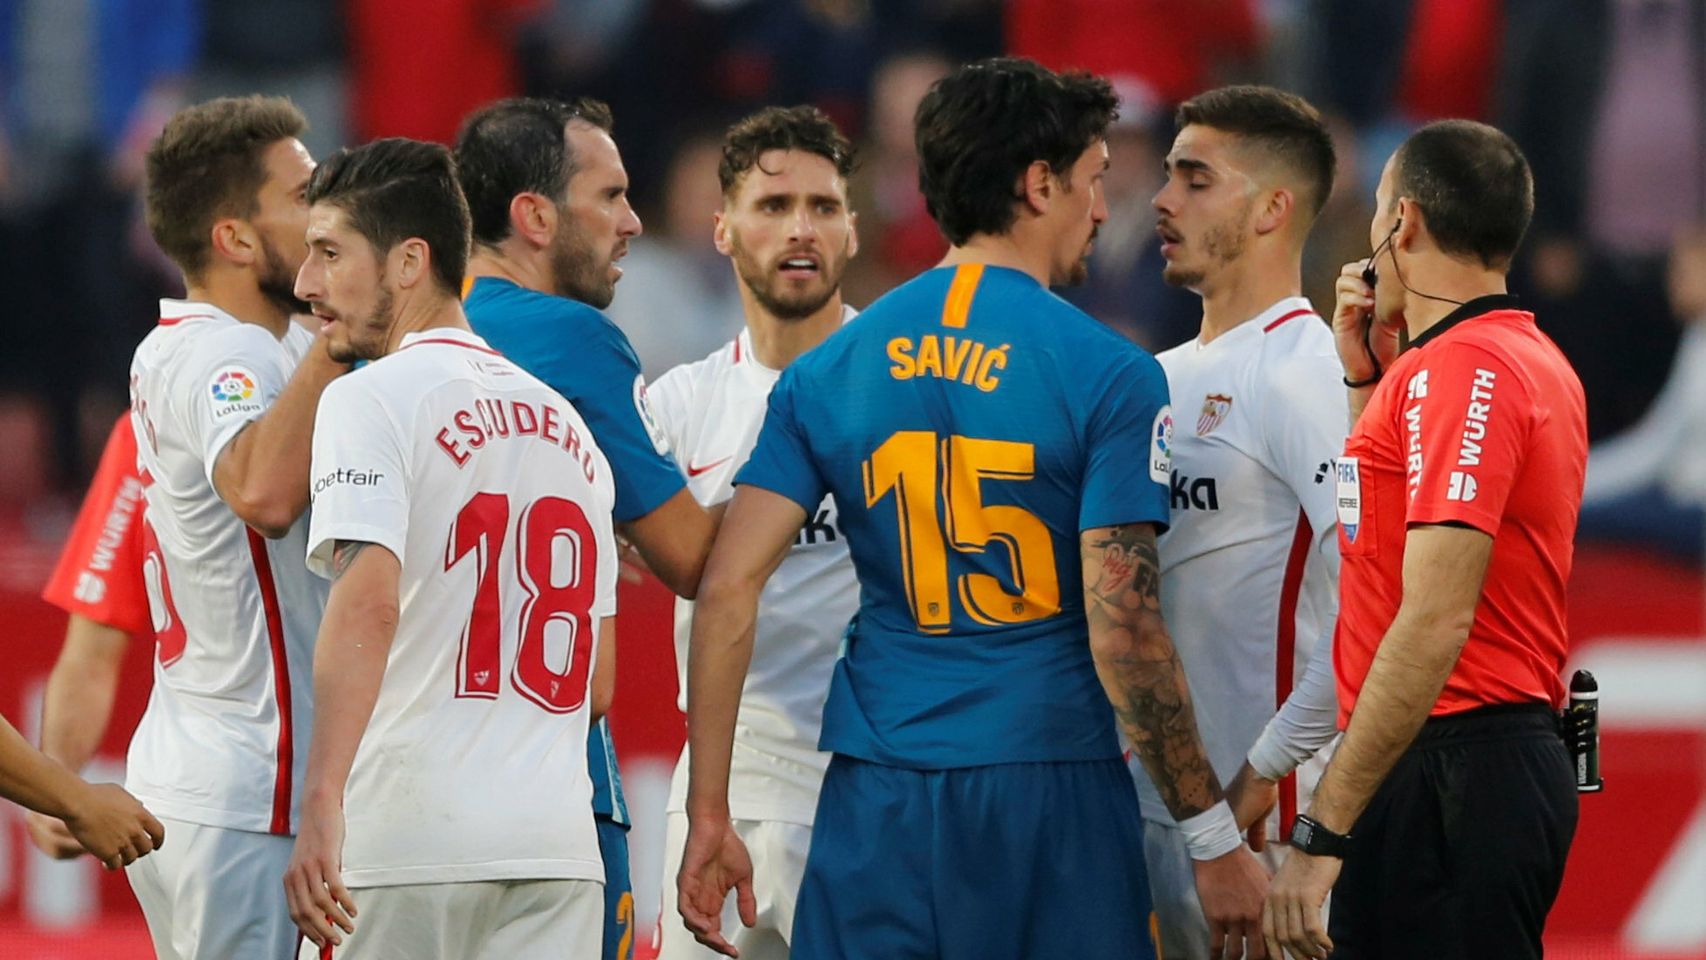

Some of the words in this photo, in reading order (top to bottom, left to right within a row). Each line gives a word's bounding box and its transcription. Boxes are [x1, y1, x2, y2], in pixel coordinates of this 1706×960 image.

[886, 335, 1011, 393] SAVIĆ
[216, 402, 261, 418] LaLiga
[435, 398, 595, 485] ESCUDERO
[1458, 368, 1496, 466] WÜRTH
[1169, 468, 1219, 511] ka
[1338, 463, 1357, 483] FIFA
[862, 431, 1062, 634] 15
[444, 491, 598, 714] 18
